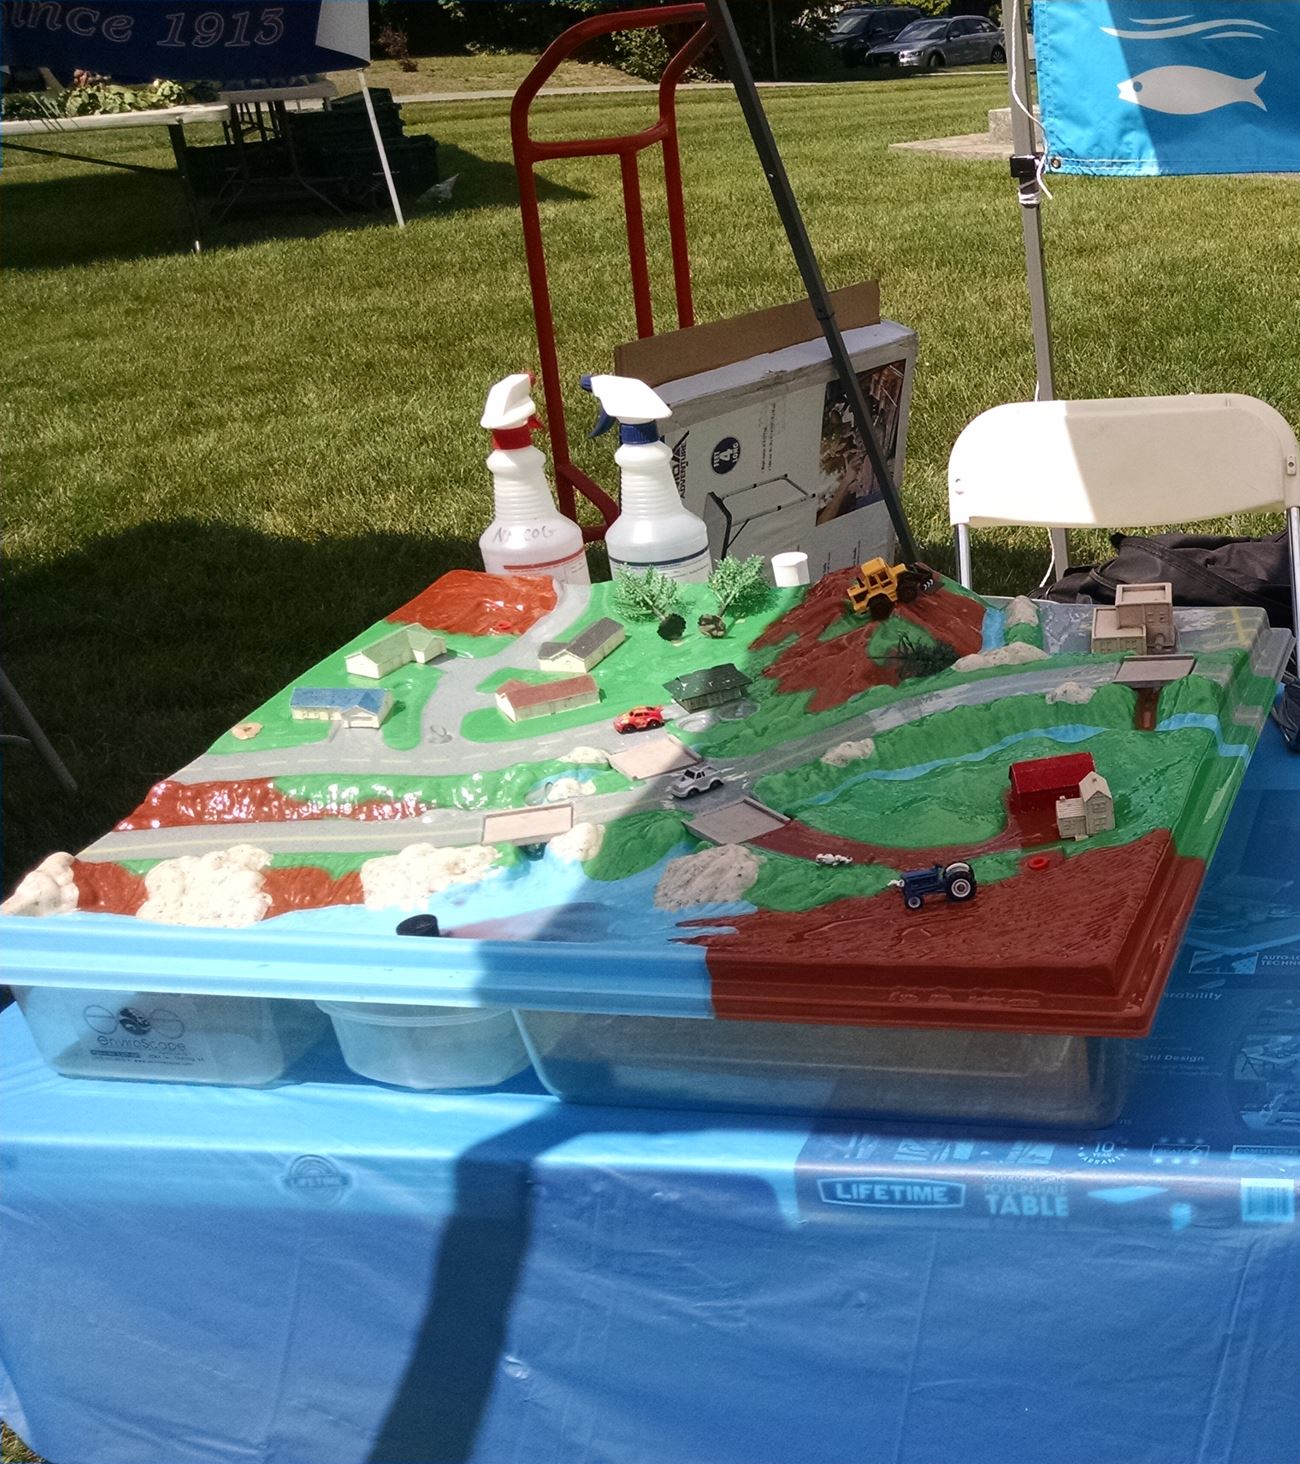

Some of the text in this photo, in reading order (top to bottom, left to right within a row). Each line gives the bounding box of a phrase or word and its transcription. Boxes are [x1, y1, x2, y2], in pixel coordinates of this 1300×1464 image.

[0, 0, 134, 42] ince
[720, 448, 732, 461] 4
[1163, 991, 1223, 1000] rability
[1164, 1054, 1205, 1063] Design
[1095, 1141, 1115, 1153] 10
[835, 1183, 948, 1202] LIFETIME
[984, 1194, 1069, 1216] TABLE
